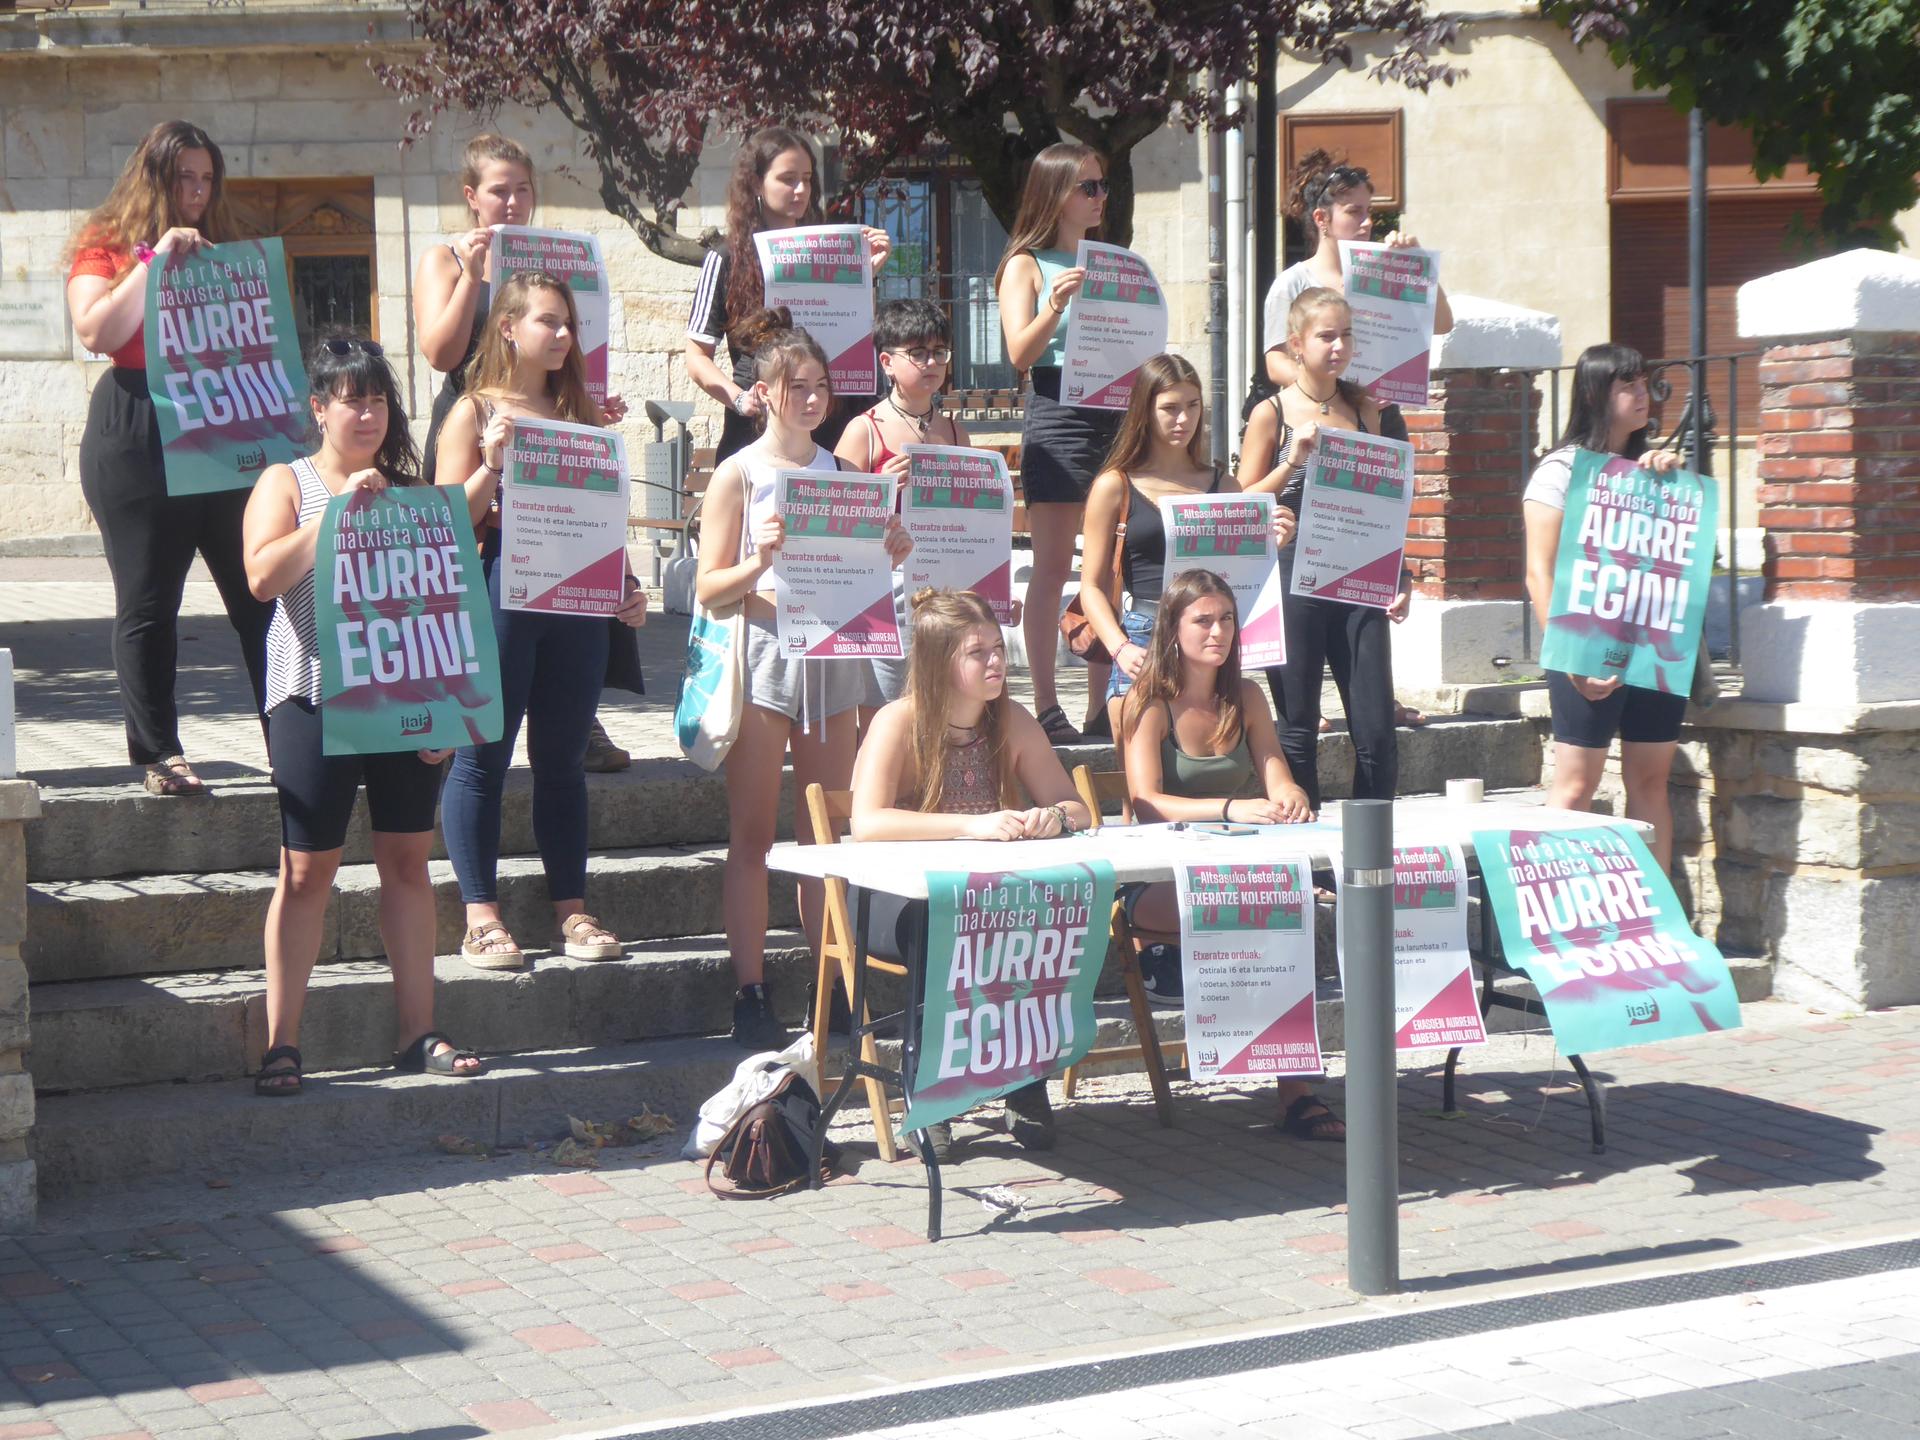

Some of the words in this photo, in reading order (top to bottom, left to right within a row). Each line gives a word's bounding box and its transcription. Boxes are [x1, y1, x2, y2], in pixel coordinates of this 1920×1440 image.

[552, 242, 584, 255] festetan
[819, 238, 852, 249] festetan
[156, 256, 267, 286] Indarkeria
[156, 282, 225, 307] matxista
[231, 275, 269, 298] orori
[158, 298, 279, 357] AURRE
[164, 360, 302, 431] EGIN!
[526, 433, 568, 448] Altsasuko
[571, 437, 606, 452] festetan
[1366, 447, 1397, 462] festetan
[561, 454, 625, 472] KOLEKTIBOAK
[921, 459, 959, 471] Altsasuko
[960, 461, 992, 473] festetan
[798, 485, 841, 497] Altsasuko
[843, 488, 879, 500] festetan
[1588, 466, 1703, 505] Indarkeria
[512, 500, 545, 512] Etxeratze
[547, 503, 576, 514] orduak:
[832, 504, 895, 518] KOLEKTIBOAK
[1586, 487, 1656, 514] matxista
[1661, 502, 1702, 522] orori
[335, 502, 452, 528] Indarkeria
[1184, 508, 1223, 519] Altsasuko
[1224, 508, 1257, 518] festetan
[566, 519, 599, 528] larunbata
[910, 523, 941, 532] Etxeratze
[1217, 523, 1273, 536] KOLEKTIBOAK
[333, 525, 411, 550] matxista
[418, 521, 456, 544] orori
[1576, 504, 1699, 566] AURRE
[781, 552, 814, 562] Etxeratze
[815, 552, 843, 562] orduak:
[333, 545, 468, 604] AURRE
[558, 586, 588, 598] ERASOEN
[589, 588, 619, 600] AURREAN
[1567, 558, 1690, 634] EGIN!
[552, 598, 578, 610] BABESA
[786, 604, 805, 614] Non?
[868, 632, 897, 642] AURREAN
[336, 611, 480, 687] EGIN!
[833, 644, 861, 654] BABESA
[862, 644, 899, 654] ANTOLATU!
[1402, 851, 1440, 864] festetan
[1498, 836, 1631, 864] Indarkeria
[1200, 871, 1246, 884] Altsasuko
[1248, 870, 1288, 884] festetan
[1508, 858, 1590, 884] matxista
[1594, 855, 1639, 874] orori
[1396, 869, 1463, 886] KOLEKTIBOAK
[953, 877, 1094, 909] Indarkeria
[1184, 891, 1239, 906] ETXERATZE
[1241, 890, 1309, 905] KOLEKTIBOAK
[1515, 870, 1662, 939] AURRE
[953, 905, 1037, 933] matxista
[1045, 899, 1091, 925] orori
[1193, 950, 1229, 960] Etxeratze
[1231, 949, 1261, 960] orduak:
[1406, 943, 1440, 952] larunbata
[946, 927, 1089, 992] AURRE
[1198, 967, 1227, 975] Ostirala
[1239, 966, 1251, 974] eta
[1252, 965, 1287, 973] larunbata
[1196, 1014, 1217, 1025] Non?
[1412, 1018, 1445, 1031] ERASOEN
[1446, 1016, 1478, 1029] AURREAN
[937, 992, 1075, 1079] EGIN!
[1202, 1029, 1231, 1039] Karpako
[1232, 1029, 1254, 1037] atean
[1410, 1032, 1441, 1045] BABESA
[1441, 1029, 1482, 1043] ANTOLATU!
[1251, 1043, 1283, 1056] ERASOEN
[1284, 1042, 1315, 1055] AURREAN
[1247, 1057, 1277, 1071] BABESA
[1278, 1056, 1317, 1070] ANTOLATU!
